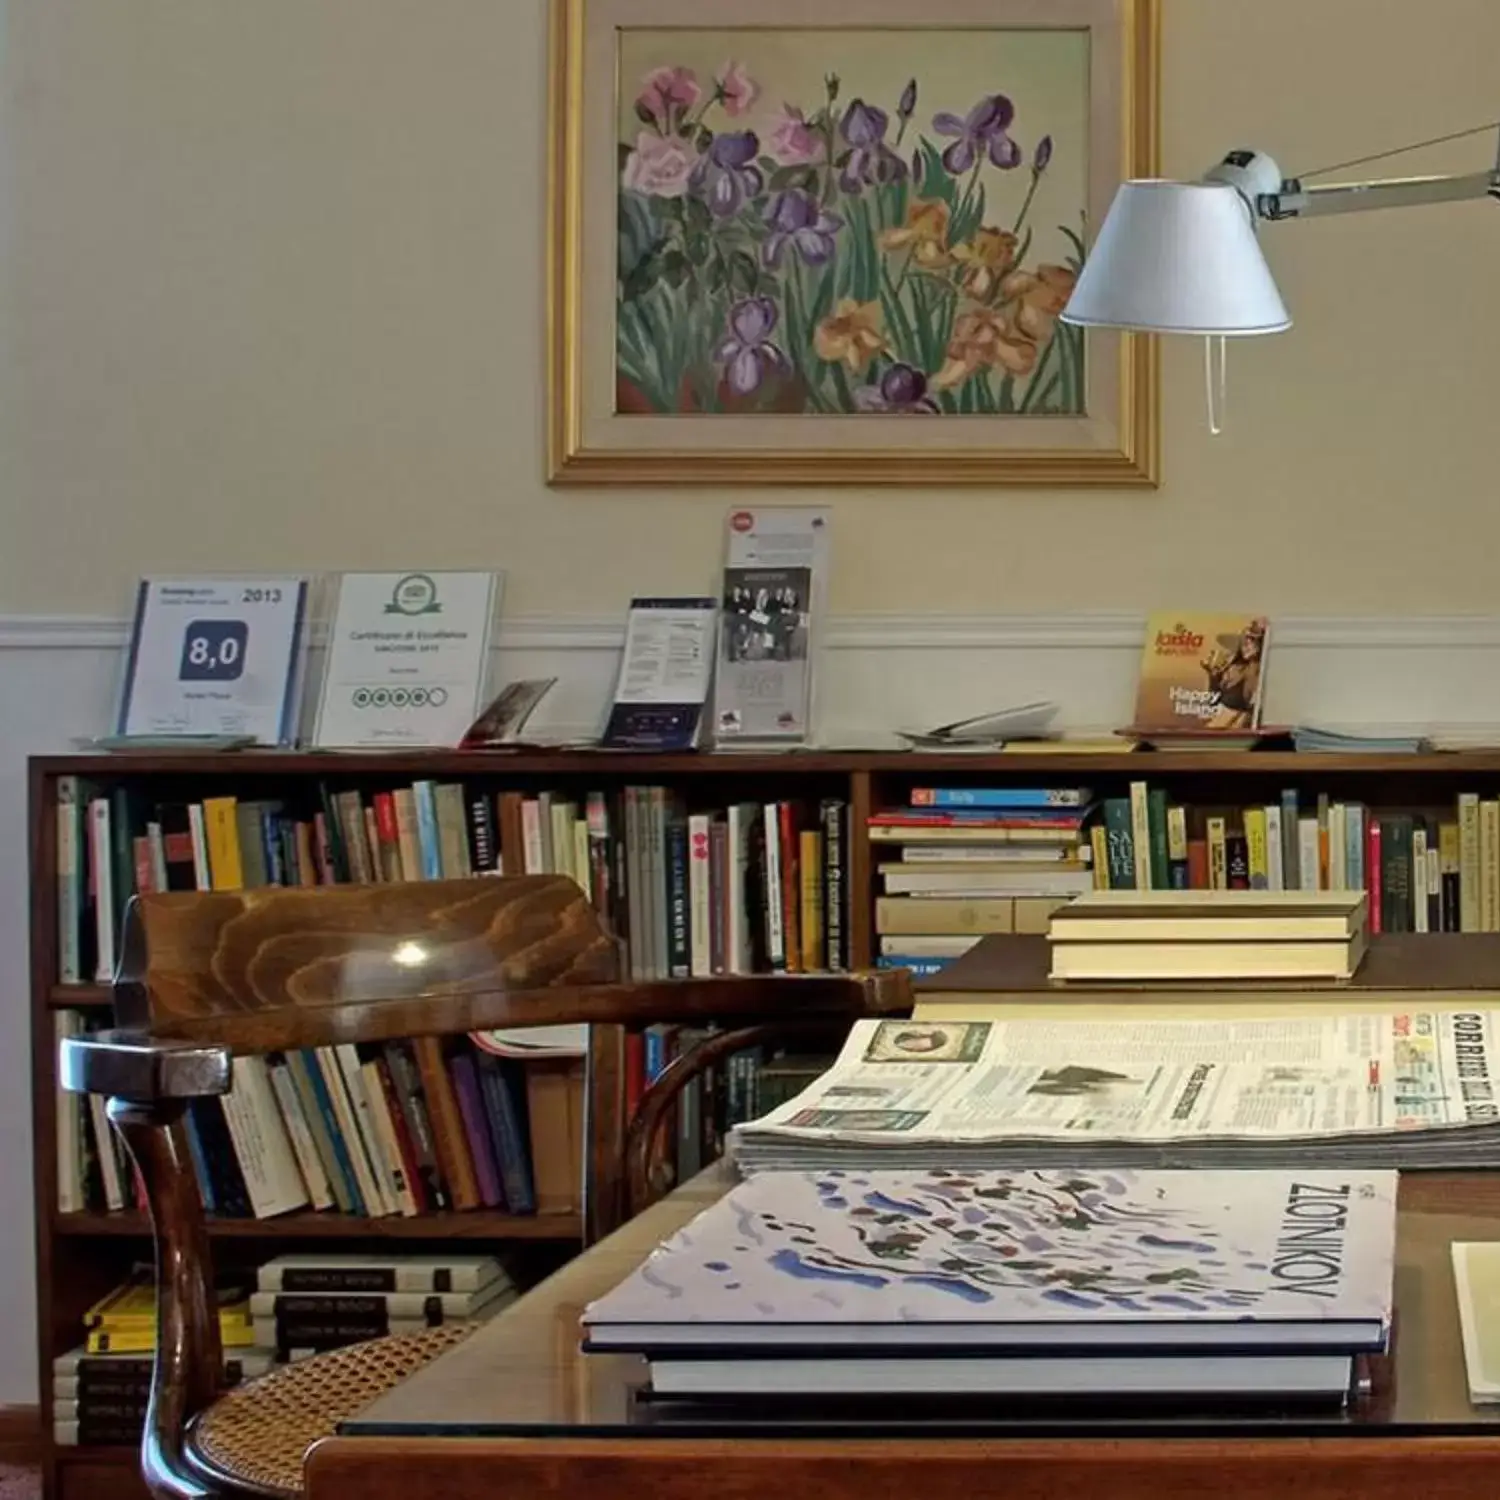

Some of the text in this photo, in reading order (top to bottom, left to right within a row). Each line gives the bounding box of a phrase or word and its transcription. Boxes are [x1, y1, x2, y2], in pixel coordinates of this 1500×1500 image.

[241, 588, 283, 604] 2013
[188, 636, 239, 670] 8,0
[1169, 686, 1222, 707] Happy
[1452, 1013, 1489, 1078] CORRIERE
[1267, 1182, 1350, 1298] ZLOTNIKOV
